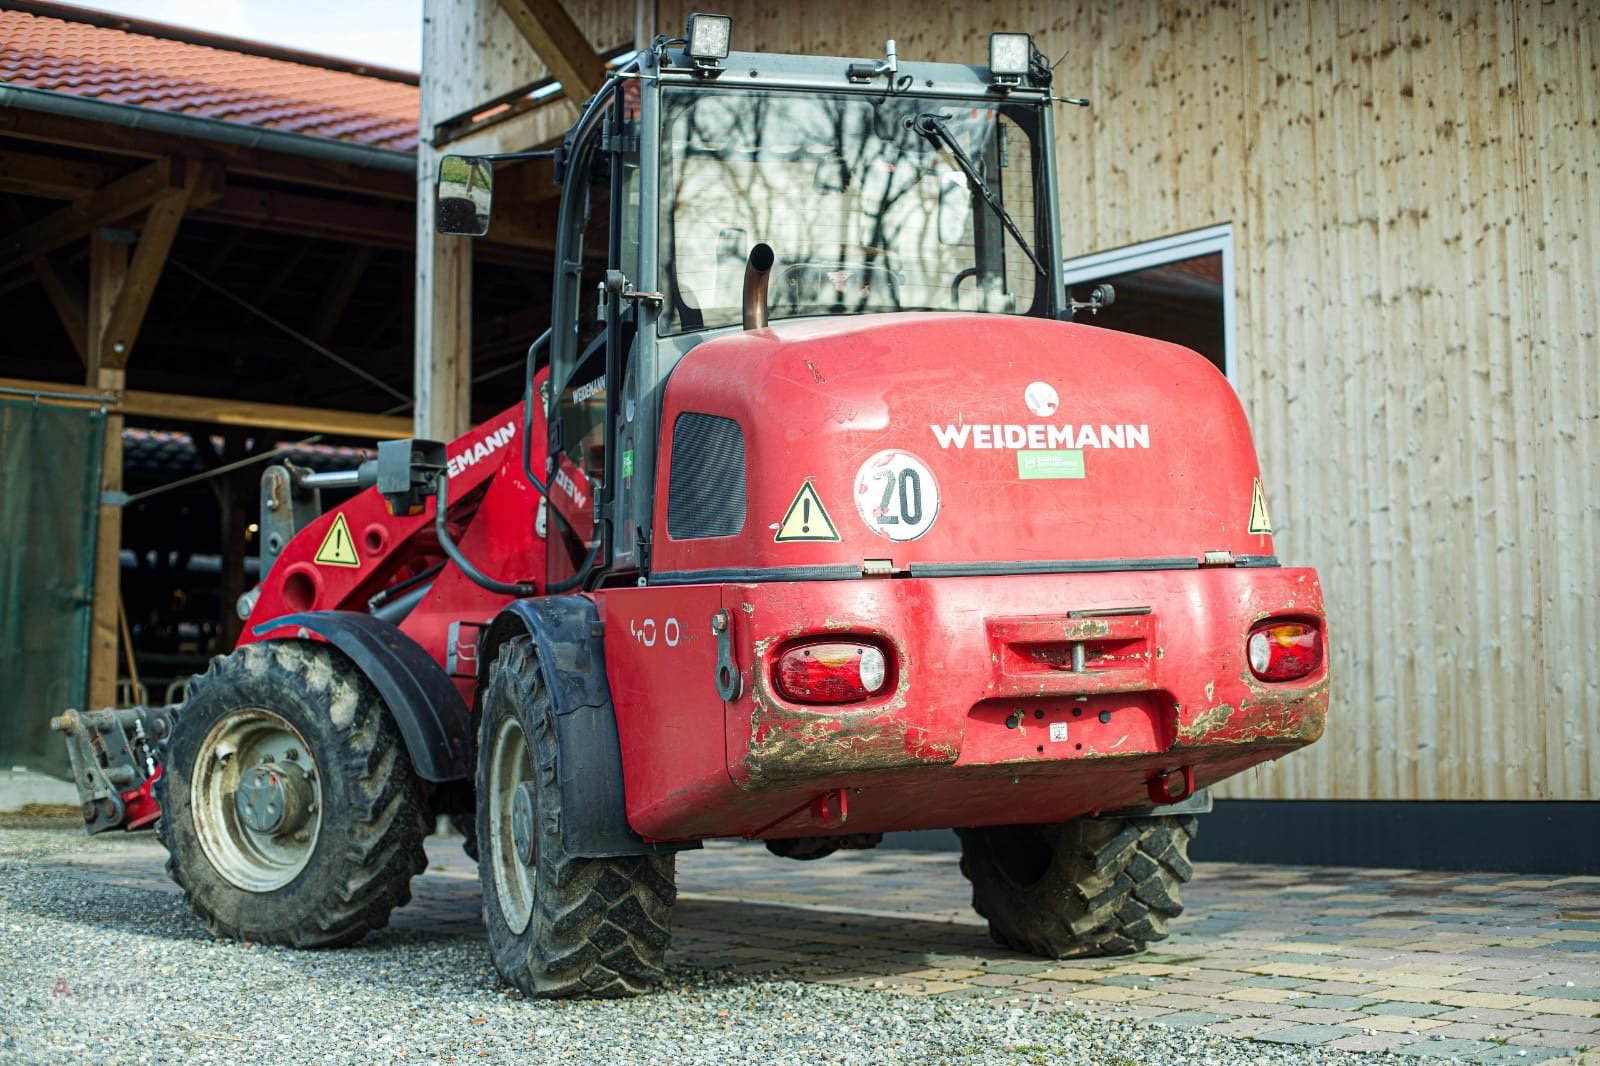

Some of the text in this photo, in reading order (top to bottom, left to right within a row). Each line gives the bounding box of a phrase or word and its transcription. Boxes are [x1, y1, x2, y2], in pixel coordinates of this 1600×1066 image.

[447, 421, 517, 479] EMANN
[930, 423, 1150, 449] WEIDEMANN
[872, 467, 922, 526] 20
